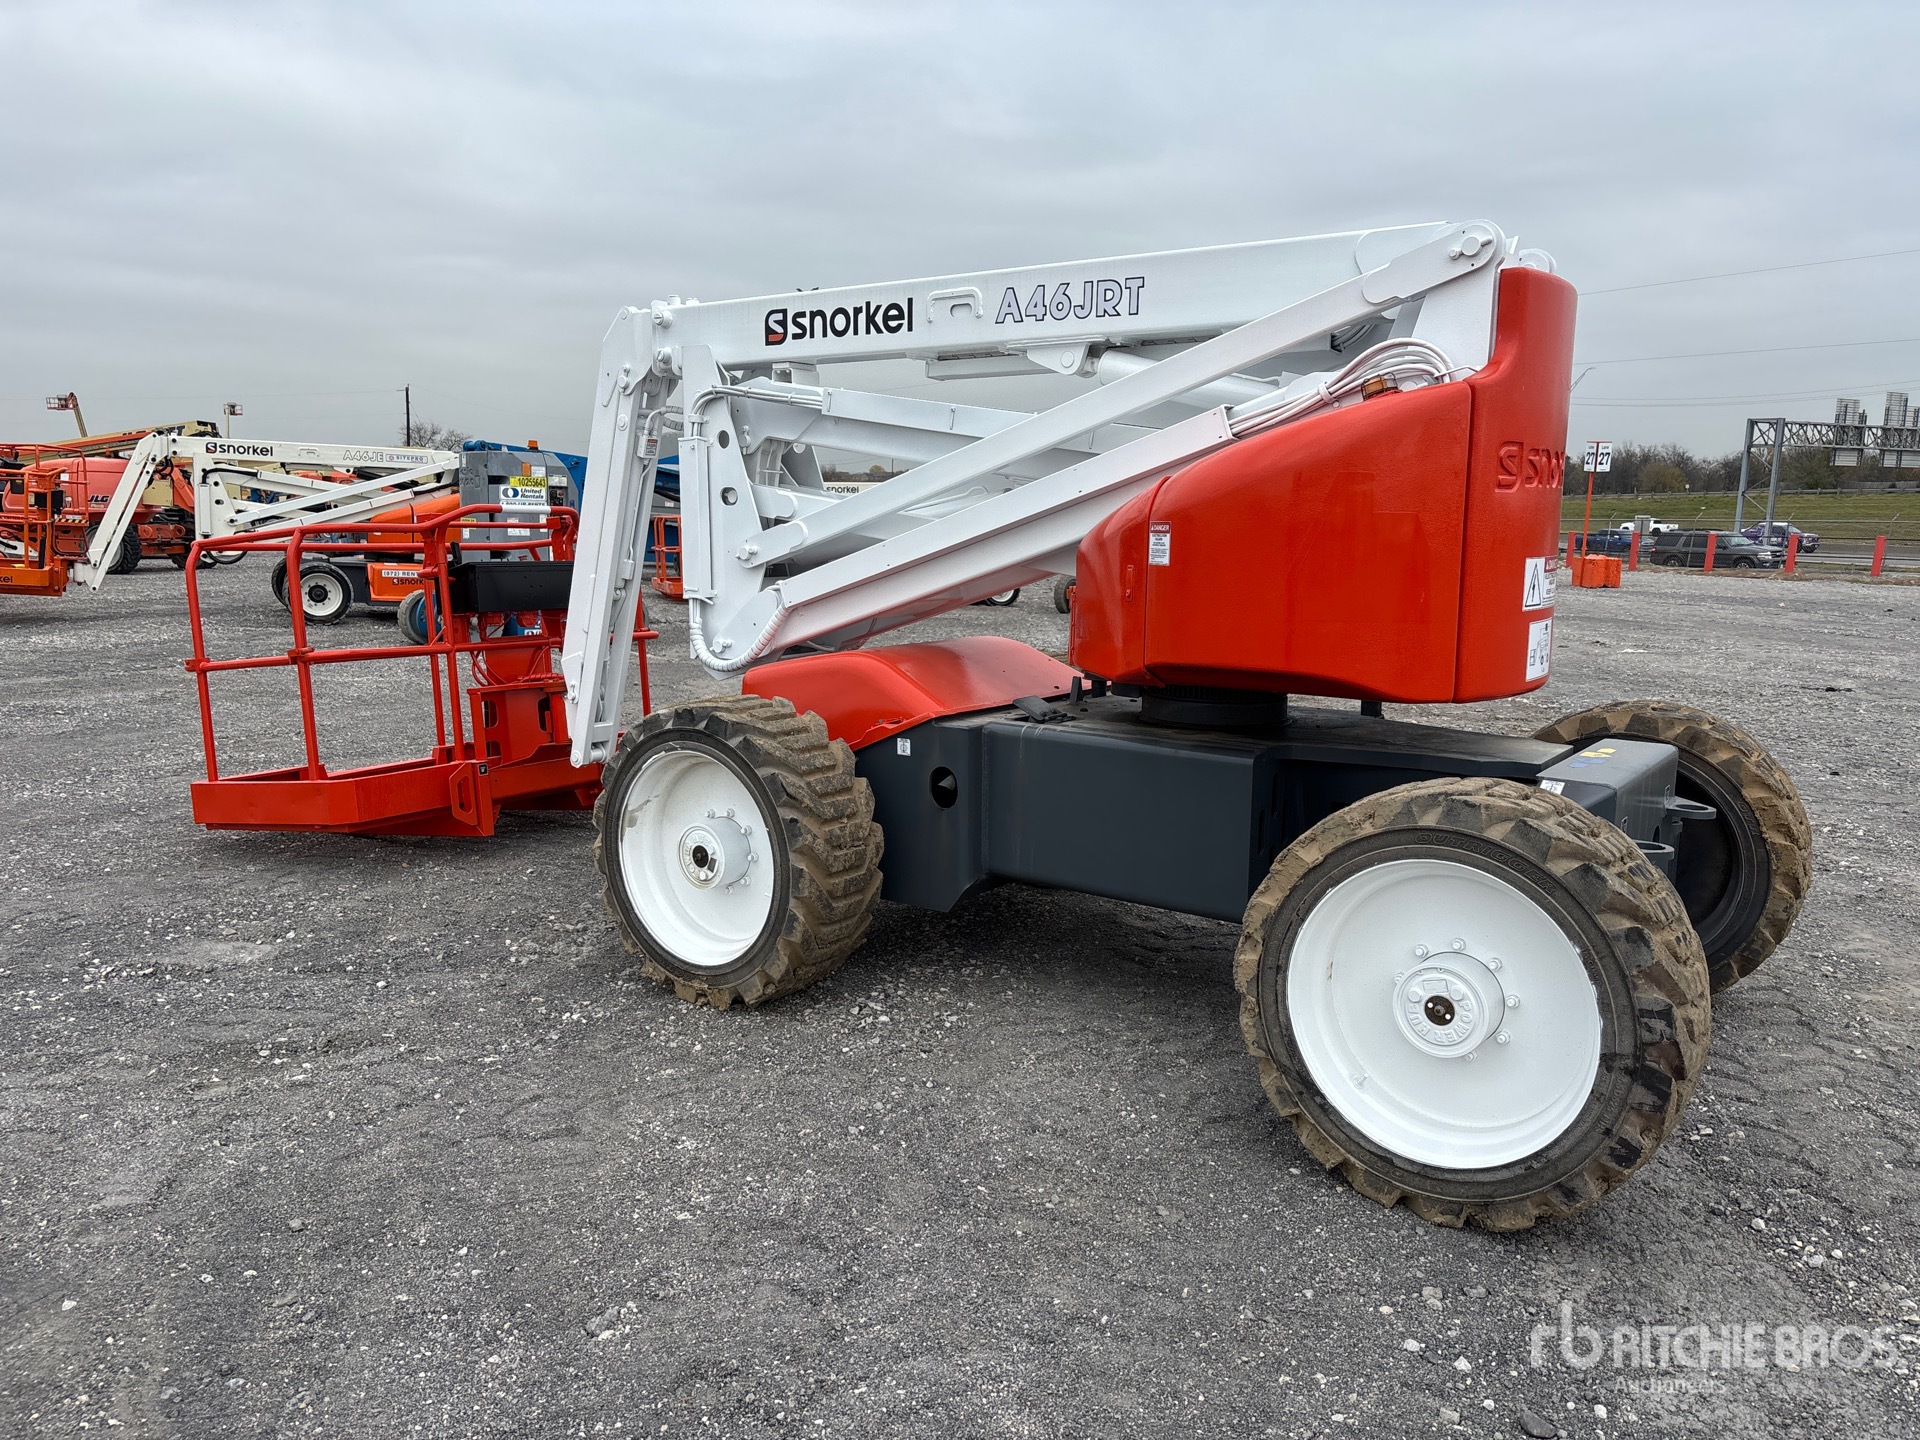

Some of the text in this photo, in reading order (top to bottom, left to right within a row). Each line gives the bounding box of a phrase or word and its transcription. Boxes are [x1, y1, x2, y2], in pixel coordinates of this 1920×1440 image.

[995, 276, 1145, 324] A46JRT
[791, 297, 913, 340] snorkel
[219, 443, 274, 457] snorkel
[342, 449, 384, 463] A46JE
[1586, 452, 1595, 465] 27
[1598, 452, 1611, 465] 27
[87, 495, 110, 503] JLG
[1415, 832, 1556, 897] OUTRIGGER
[1434, 1000, 1473, 1043] POWER
